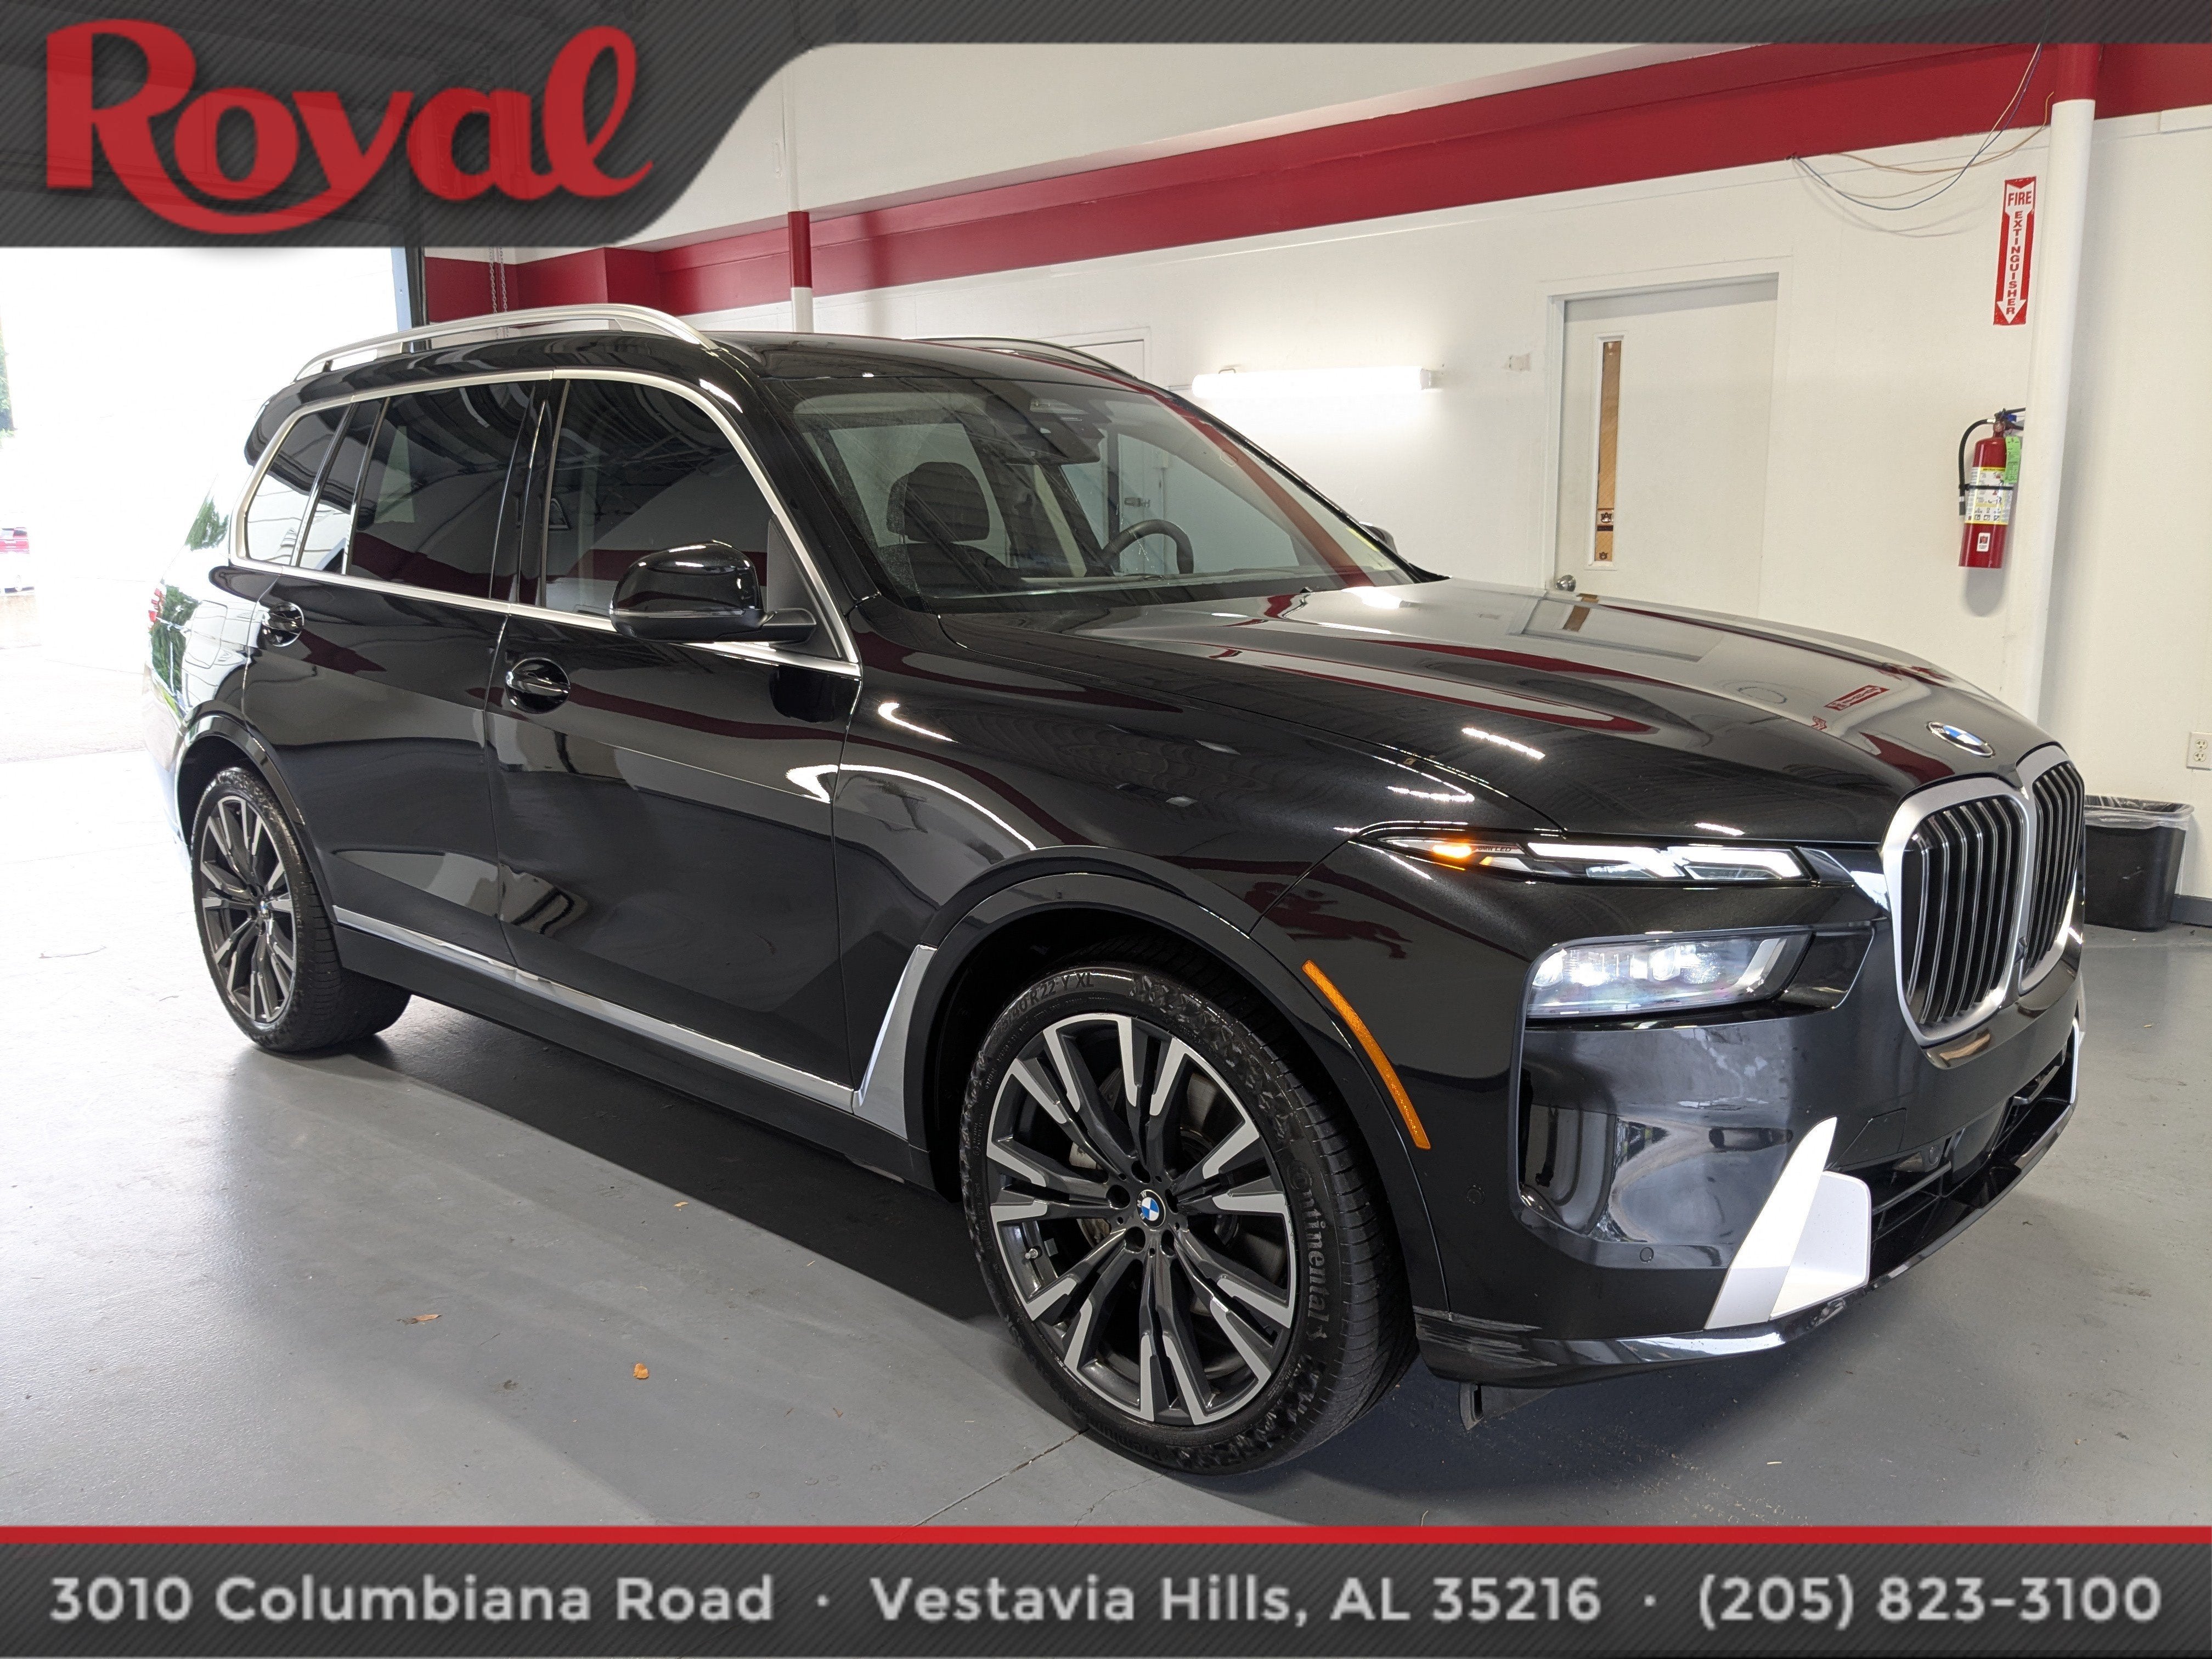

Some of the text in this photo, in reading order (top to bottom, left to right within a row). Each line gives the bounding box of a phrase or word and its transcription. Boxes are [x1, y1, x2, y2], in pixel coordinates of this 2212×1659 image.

[2007, 190, 2032, 206] FIRE
[2006, 210, 2023, 315] EXTINGUISHER
[1075, 972, 1094, 988] XL
